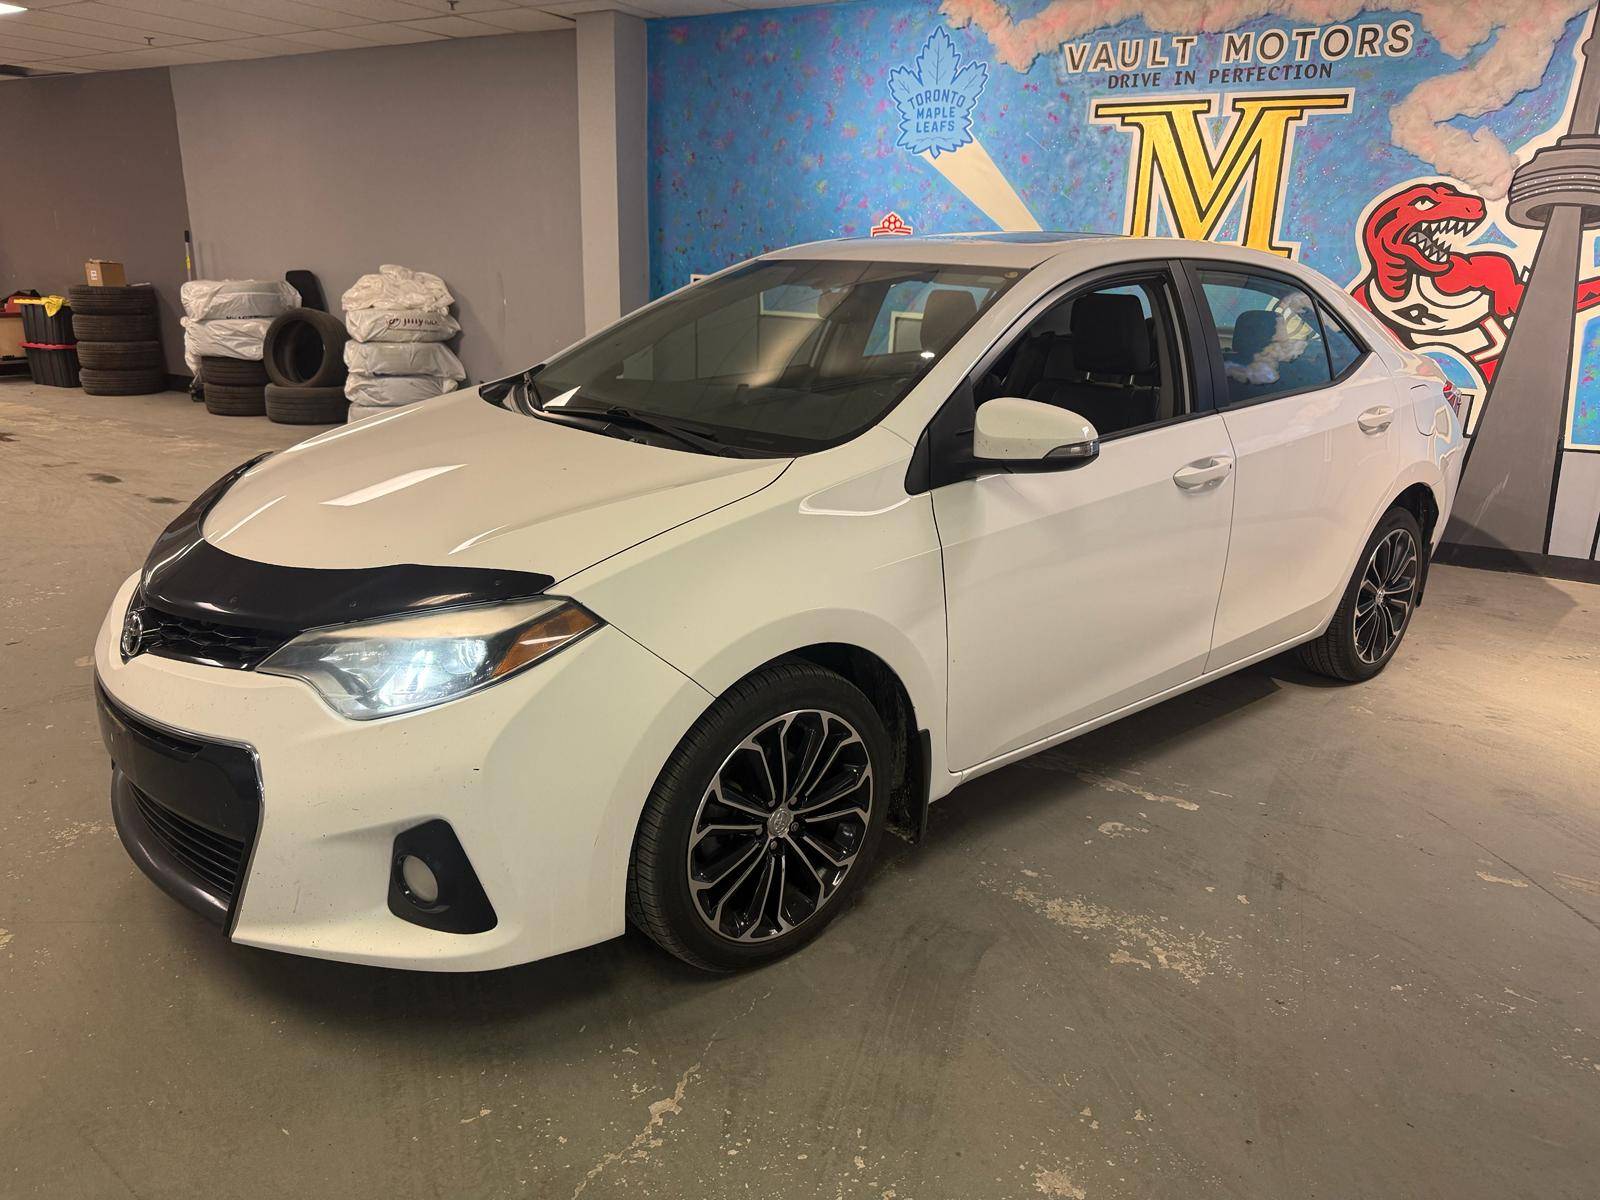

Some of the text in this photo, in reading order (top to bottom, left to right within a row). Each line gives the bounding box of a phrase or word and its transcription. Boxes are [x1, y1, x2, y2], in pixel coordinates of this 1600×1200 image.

[1064, 21, 1414, 73] VAULT MOTORS
[1108, 63, 1332, 89] DRIVE IN PERFECTION
[907, 89, 966, 109] TORONTO
[917, 107, 956, 119] MAPLE
[916, 121, 955, 133] LEAFS
